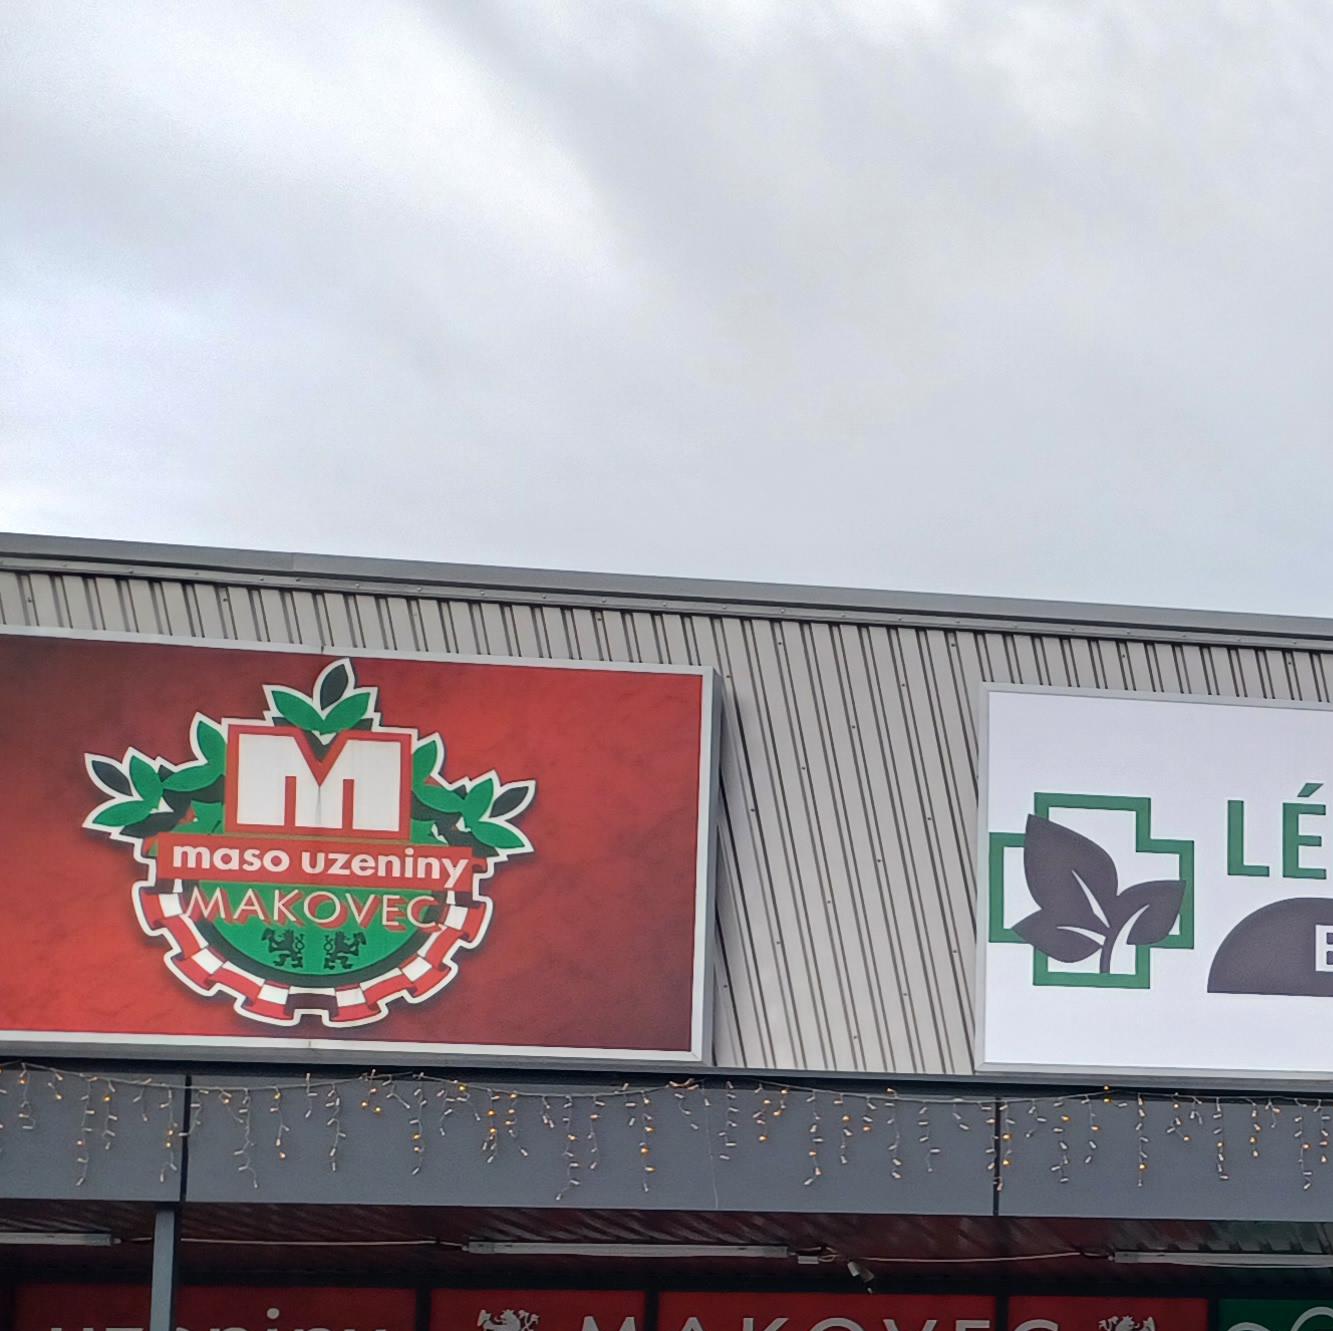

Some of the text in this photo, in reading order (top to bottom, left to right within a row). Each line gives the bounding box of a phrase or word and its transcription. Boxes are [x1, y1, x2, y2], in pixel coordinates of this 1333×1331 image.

[172, 841, 471, 888] maso uzeniny
[184, 886, 443, 931] MAKOVEC
